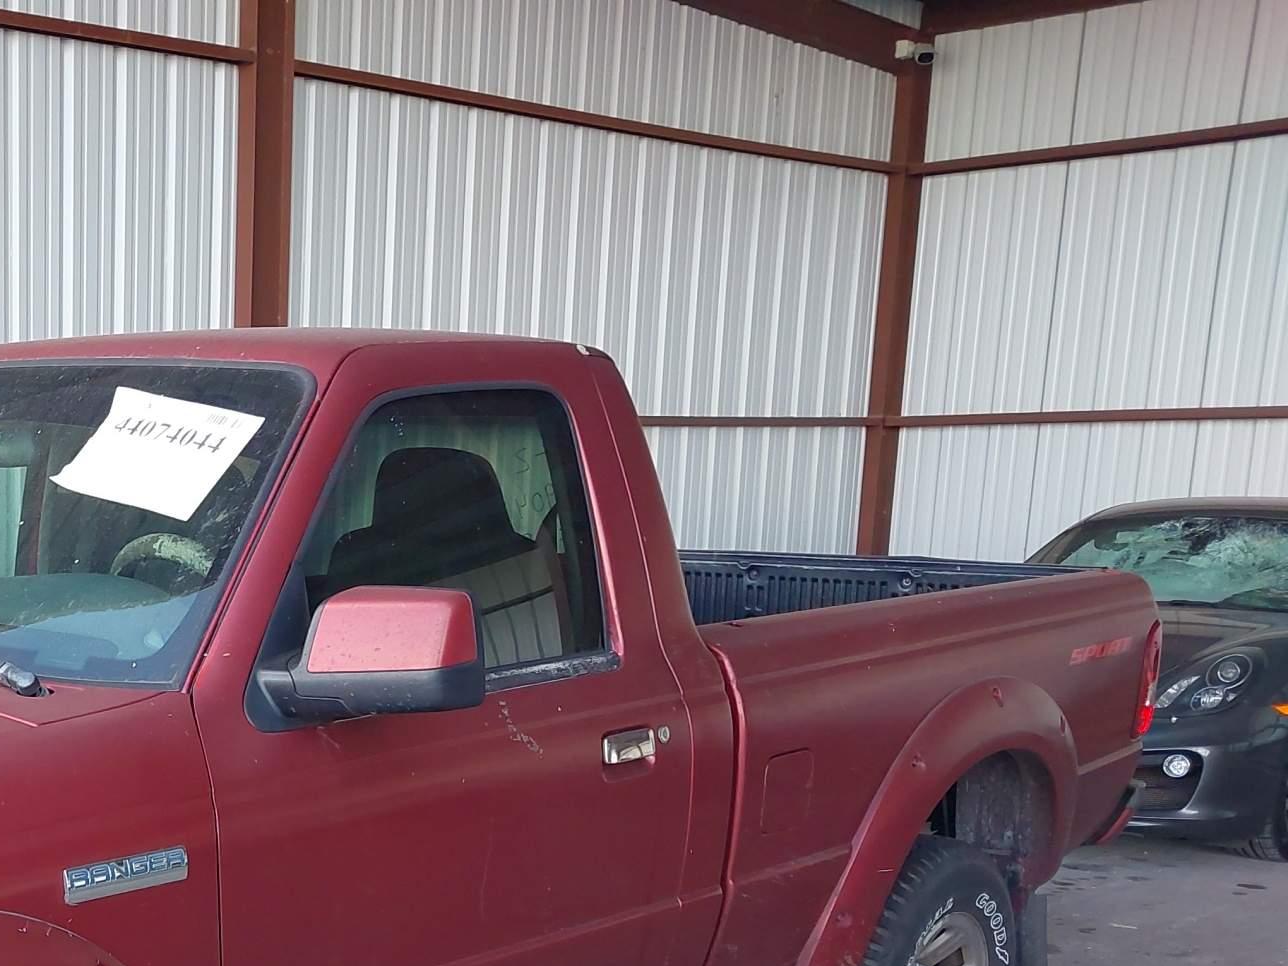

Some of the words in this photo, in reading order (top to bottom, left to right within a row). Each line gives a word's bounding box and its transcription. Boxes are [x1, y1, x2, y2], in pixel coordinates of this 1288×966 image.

[114, 417, 227, 453] 44074044
[1068, 636, 1132, 667] SPORT
[66, 847, 188, 890] RANGER
